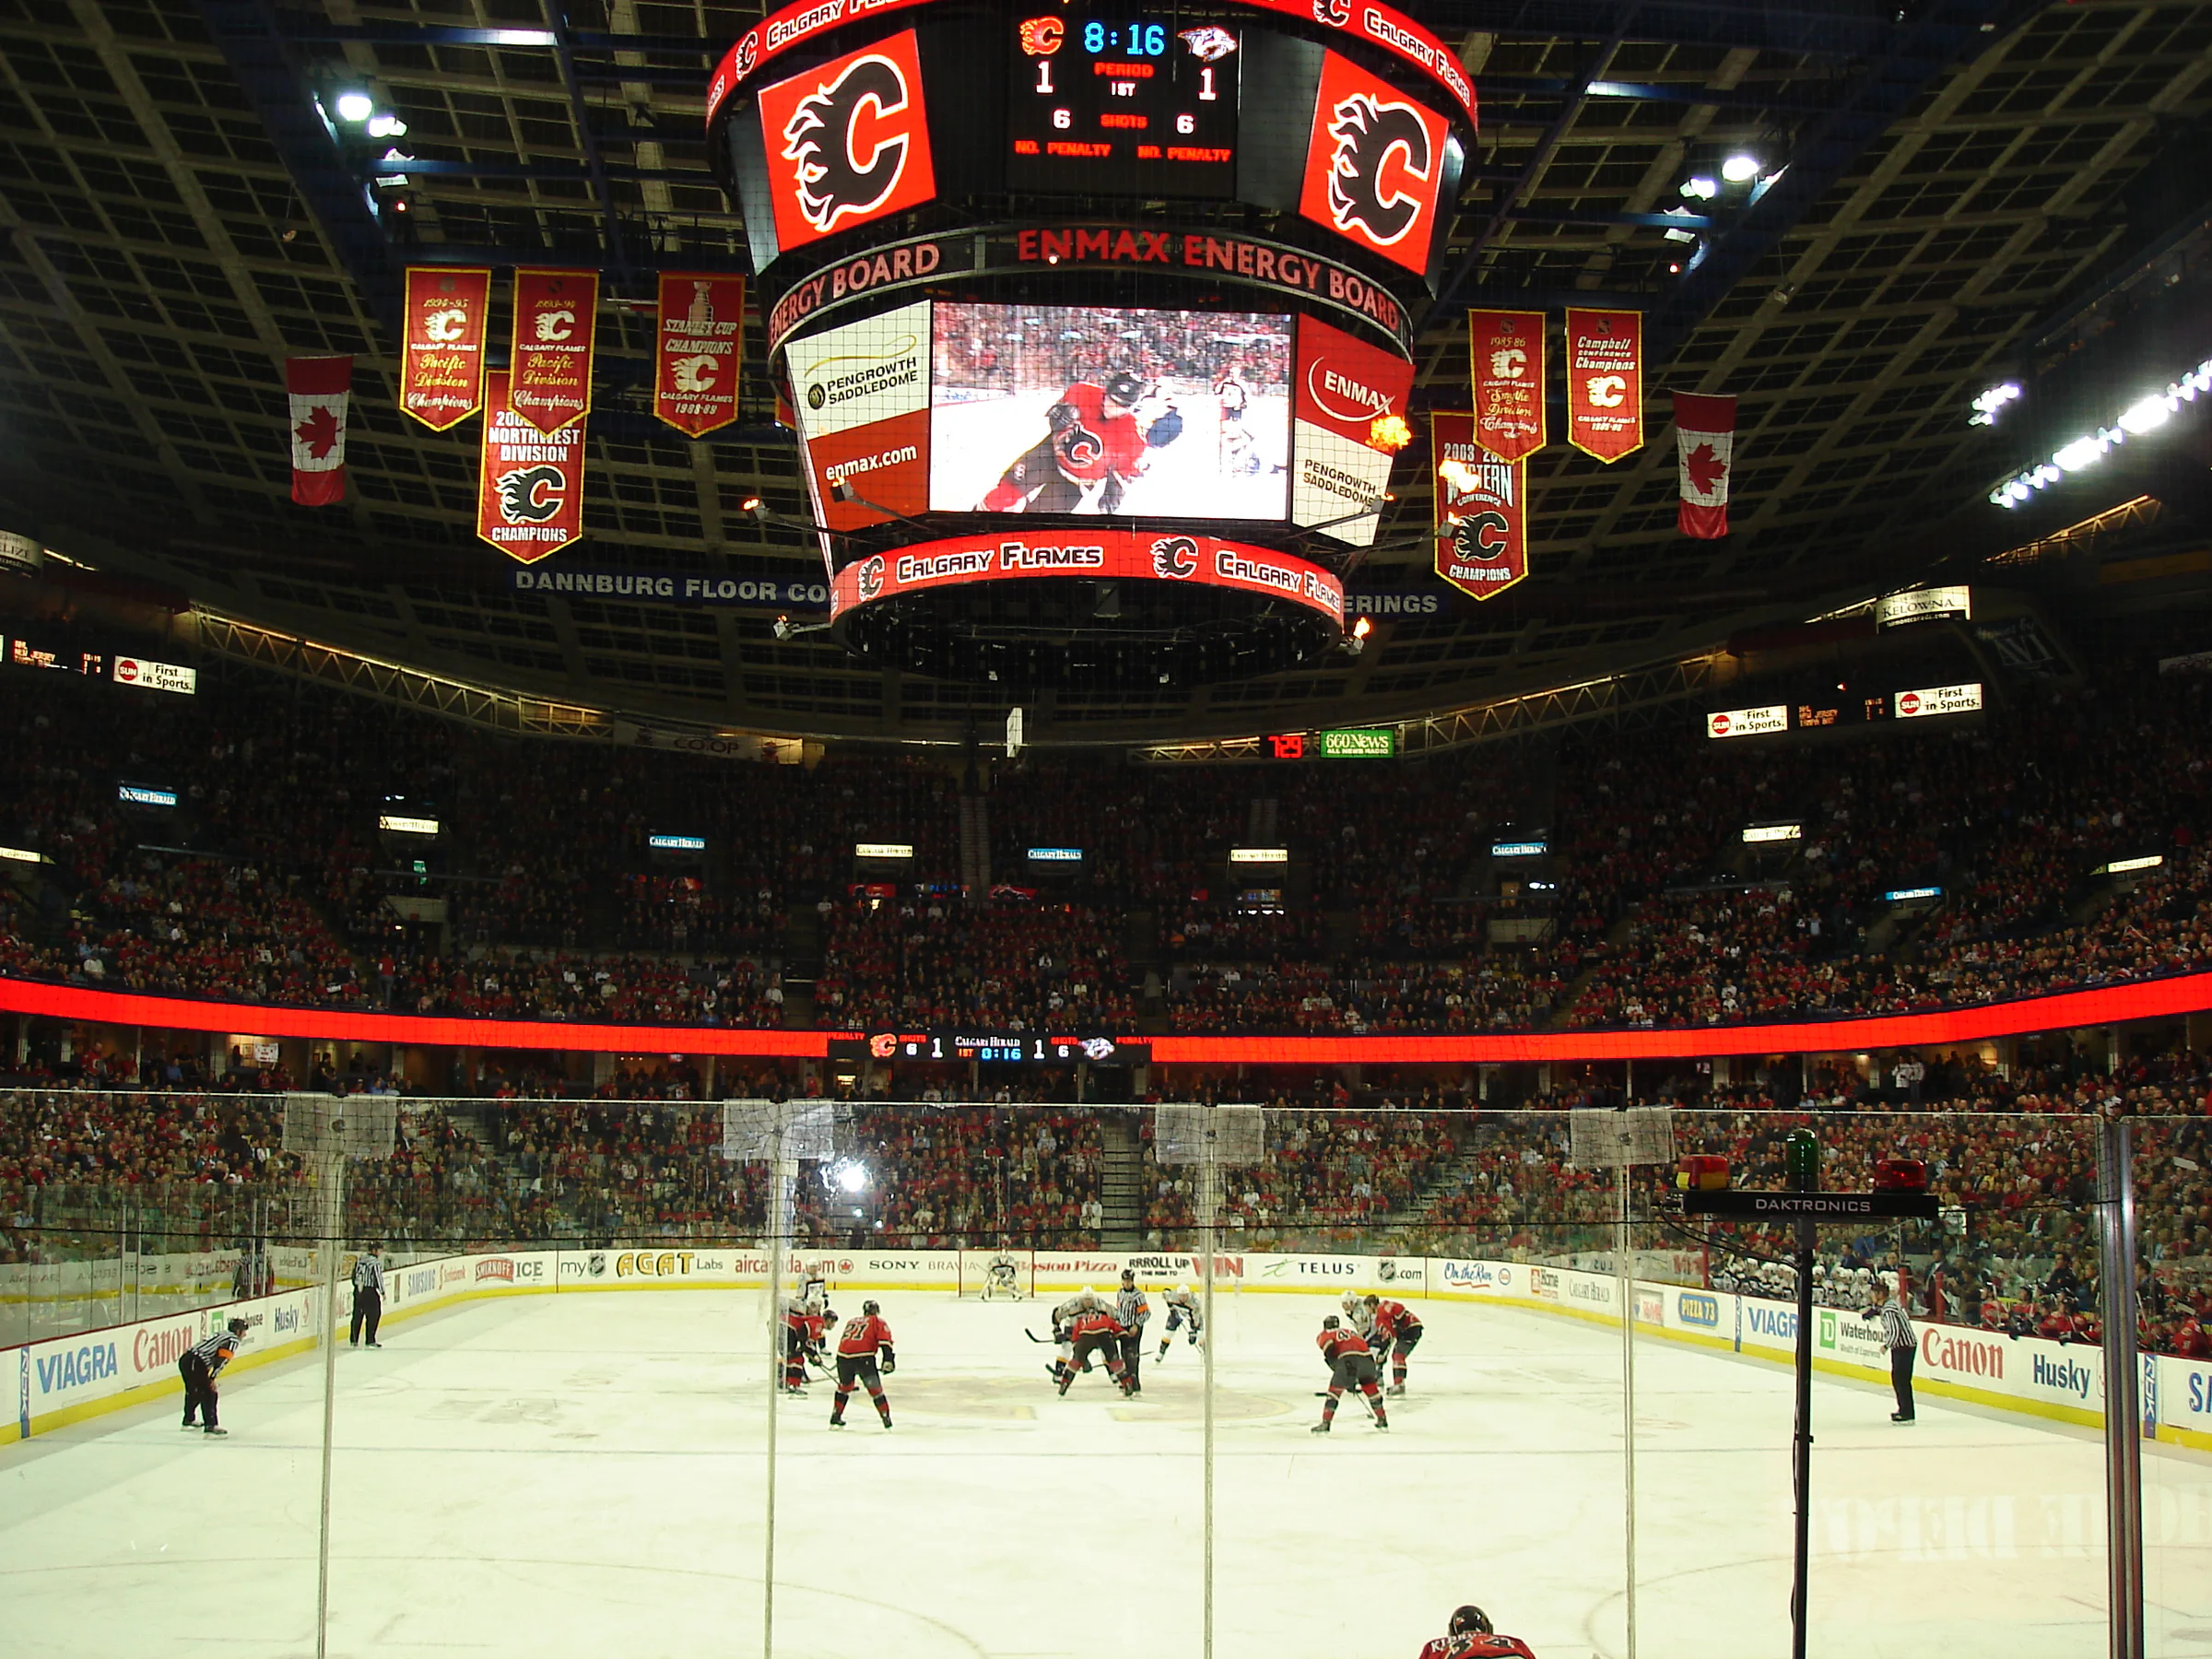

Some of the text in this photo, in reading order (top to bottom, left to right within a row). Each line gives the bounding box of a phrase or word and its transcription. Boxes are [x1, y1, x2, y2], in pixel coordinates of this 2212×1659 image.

[1084, 22, 1164, 56] 8:16
[1363, 7, 1434, 67] CALGARY
[1036, 61, 1053, 93] 1
[1094, 62, 1154, 78] PERIOD
[1198, 67, 1217, 101] 1
[1053, 109, 1071, 129] 6
[1100, 113, 1148, 129] SHOTS
[1177, 115, 1194, 135] 6
[1047, 142, 1112, 158] PENALTY
[1167, 147, 1230, 162] PENALTY
[832, 242, 940, 300] BOARD
[1018, 229, 1399, 333] ENMAX ENERGY BOARD
[664, 319, 737, 335] STANLEY CUP
[665, 338, 734, 355] CHAMPIONS
[1577, 335, 1631, 351] Campbell
[420, 354, 466, 376] Pacific
[527, 353, 575, 374] Pacific
[1575, 357, 1636, 372] Champions
[415, 371, 469, 388] Division
[523, 370, 579, 386] Division
[828, 357, 917, 392] PENGROWTH
[829, 370, 918, 406] SADDLEDOME
[1324, 370, 1392, 415] ENMAX
[1487, 387, 1529, 405] Smythe
[407, 392, 473, 411] Champions
[513, 389, 584, 412] Champions
[661, 392, 734, 403] CALGARY FLAMES
[1485, 403, 1533, 418] Division
[1479, 417, 1537, 436] Champions
[500, 445, 568, 462] DIVISION
[1444, 442, 1475, 462] 2003
[825, 445, 918, 482] enmax.com
[1304, 459, 1376, 495] PENGROWTH
[1302, 472, 1373, 507] SADDLEDOME
[491, 527, 568, 543] CHAMPIONS
[896, 542, 1103, 583] CALGARY FLAMES
[1215, 550, 1301, 593] CALGARY
[1449, 564, 1512, 582] CHAMPIONS
[515, 571, 778, 601] DANNBURG FLOOR
[1883, 599, 1955, 618] KELOWNA
[119, 665, 136, 677] SUN
[155, 665, 178, 677] First
[142, 673, 193, 691] in Sports.
[1938, 687, 1963, 698] First
[1900, 699, 1920, 710] SUN
[1925, 697, 1981, 712] in Sports.
[1747, 710, 1770, 720] First
[1712, 720, 1730, 729] SUN
[1735, 719, 1785, 733] in Sports.
[649, 836, 705, 850] CALGARY HERALD
[1492, 844, 1520, 855] CALGARY
[1028, 849, 1056, 860] CALGARY
[900, 1034, 927, 1043] SHOTS
[955, 1035, 1020, 1047] CALGARY HERALD
[906, 1042, 917, 1056] 6
[931, 1038, 943, 1058] 1
[1033, 1039, 1045, 1059] 1
[1058, 1044, 1069, 1057] 6
[1756, 1199, 1871, 1213] DAKTRONICS
[476, 1259, 543, 1281] SMIRNOFF ICE
[560, 1261, 587, 1277] my
[617, 1253, 724, 1277] AGAT Labs
[869, 1260, 977, 1271] SONY BRAVIA
[1072, 1260, 1118, 1273] Pizza
[1129, 1256, 1190, 1269] RRROLL UP
[1298, 1262, 1355, 1276] TELUS
[1396, 1268, 1422, 1280] .com
[1444, 1262, 1458, 1281] On
[1459, 1264, 1474, 1281] the
[1473, 1264, 1493, 1282] Run
[407, 1269, 436, 1297] SAMSUNG
[275, 1304, 299, 1334] Husky
[1681, 1298, 1703, 1319] PIZZA
[1704, 1301, 1715, 1322] 73
[1747, 1306, 1798, 1339] VIAGR
[133, 1324, 193, 1372] Canon
[1922, 1328, 2004, 1380] Canon
[37, 1342, 118, 1394] VIAGRA
[2033, 1353, 2090, 1399] Husky
